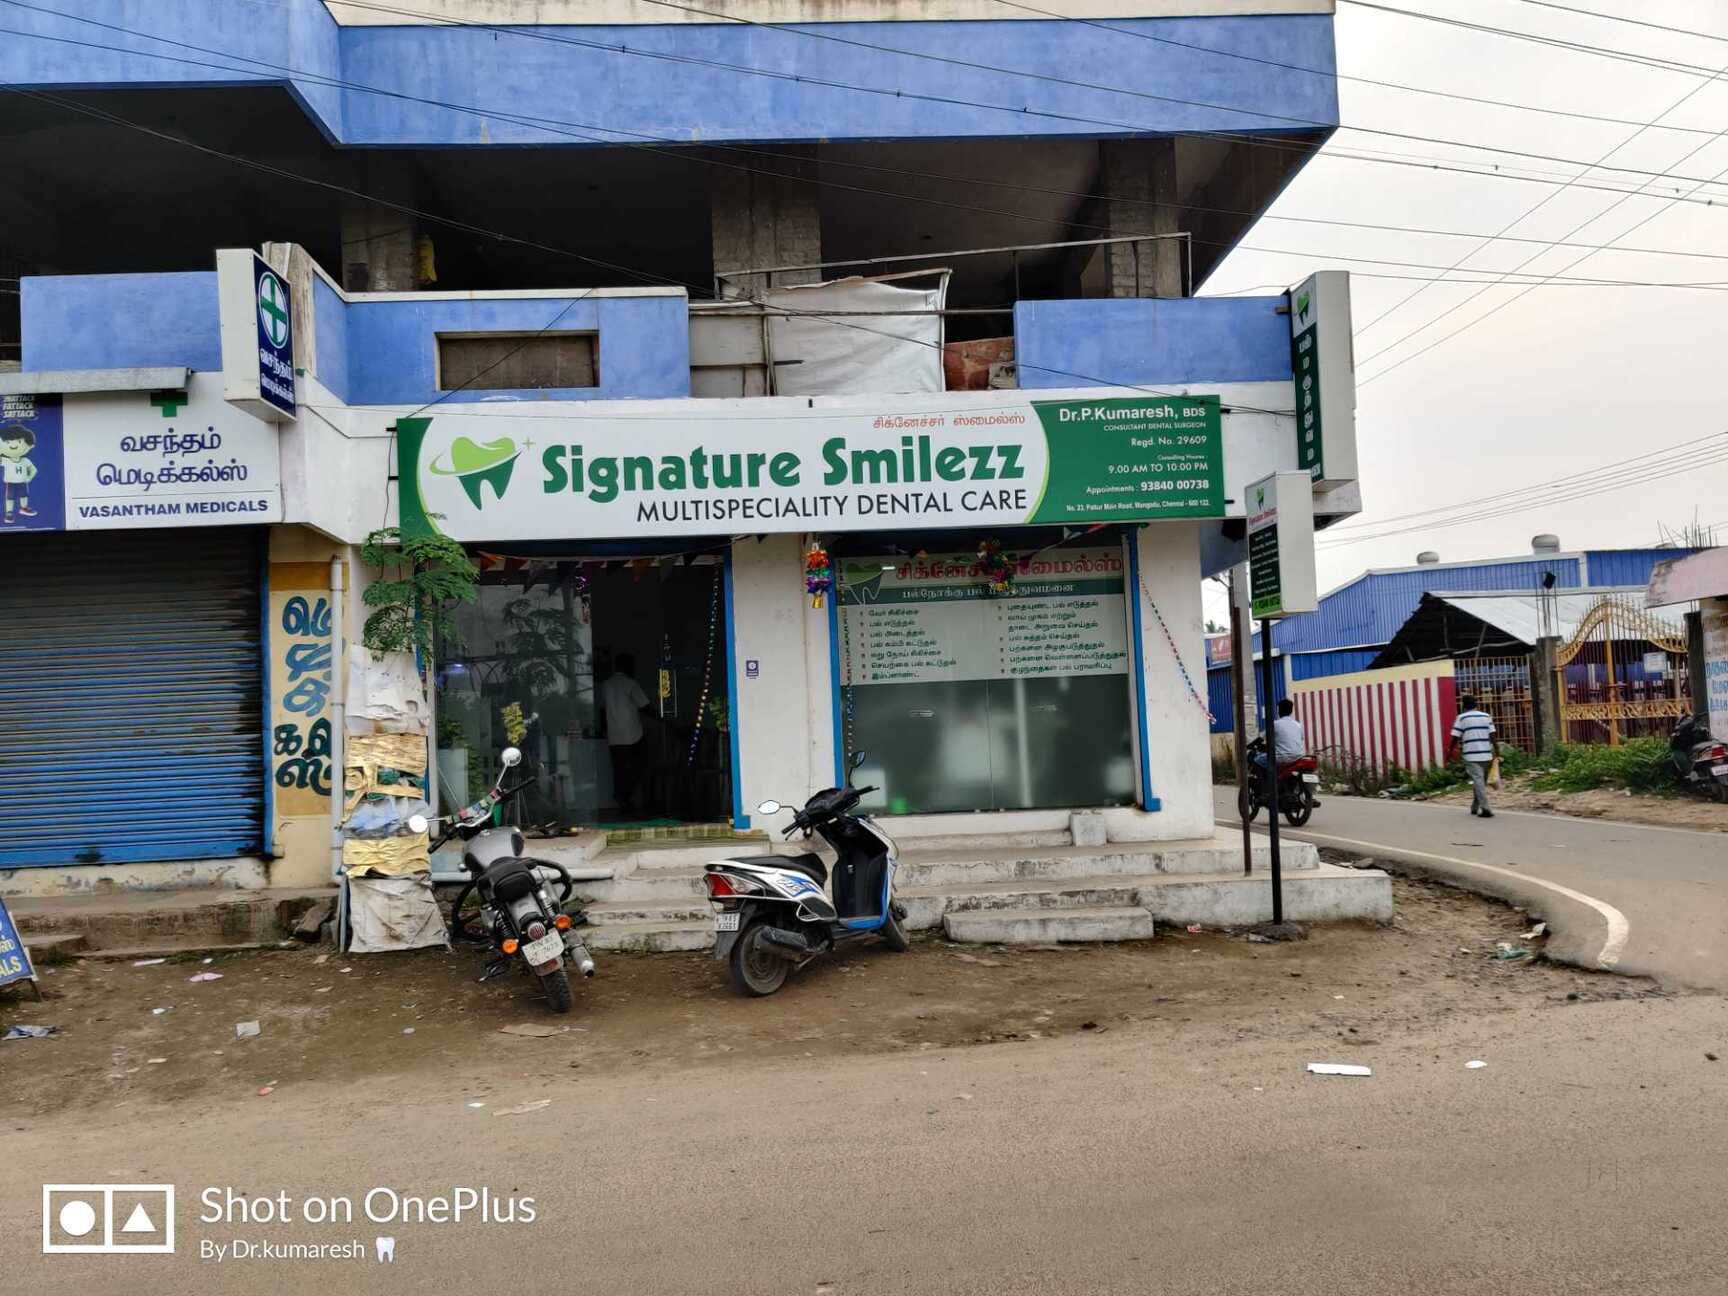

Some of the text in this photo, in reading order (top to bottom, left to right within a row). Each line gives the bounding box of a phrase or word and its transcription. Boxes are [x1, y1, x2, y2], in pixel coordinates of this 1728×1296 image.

[872, 413, 945, 429] சிக்னேச்சர்
[1059, 405, 1206, 422] Dr.P.Kumaresh, BDS
[1103, 421, 1206, 431] CONSULTANT DENTAL SURGEON
[120, 426, 222, 457] வசந்தம்
[1176, 435, 1207, 445] 29609
[96, 458, 248, 491] மெடிக்கல்ஸ்
[542, 435, 1025, 503] Signature Smilezz
[1131, 464, 1148, 473] AM
[1150, 463, 1163, 472] TO
[1194, 462, 1209, 471] PM
[1140, 480, 1174, 491] 93840
[1176, 479, 1209, 490] 00738
[79, 500, 268, 518] VASANTHAM MEDICALS
[636, 489, 1027, 522] MULTISPECIALITY DENTAL CARE
